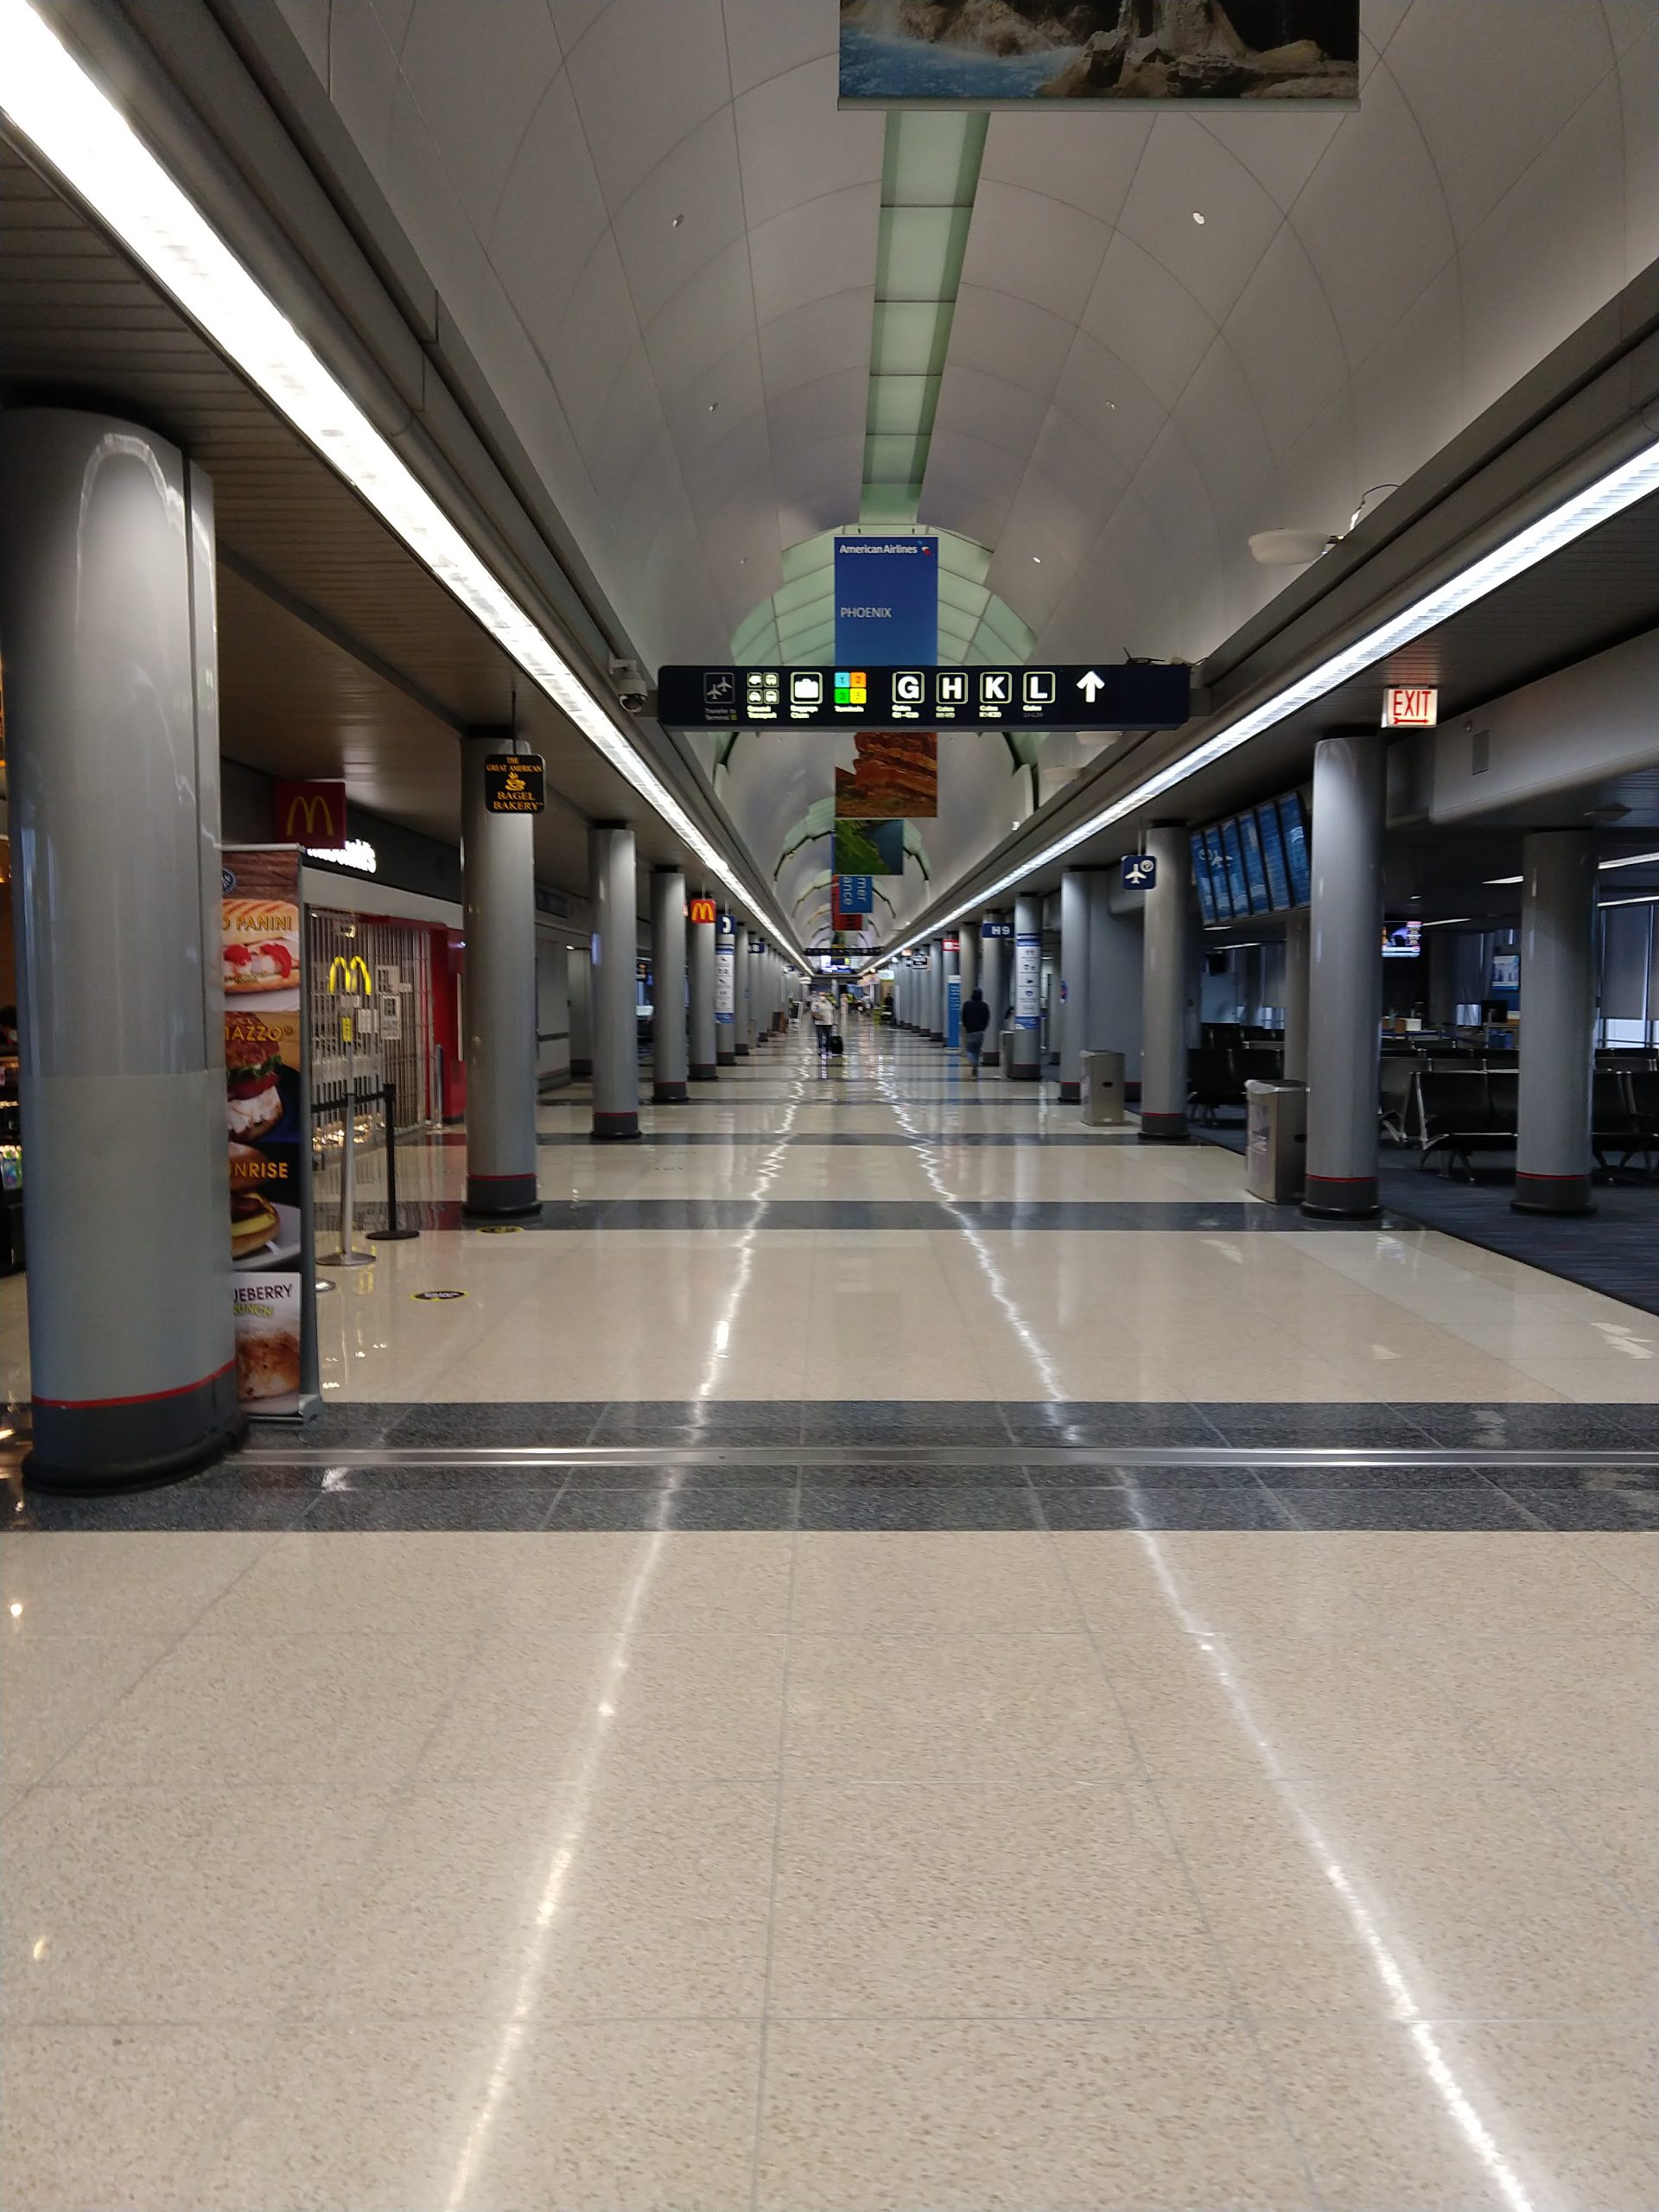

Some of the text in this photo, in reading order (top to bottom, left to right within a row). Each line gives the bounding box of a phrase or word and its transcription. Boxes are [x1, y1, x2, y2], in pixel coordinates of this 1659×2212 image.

[839, 544, 918, 554] American Airlines
[840, 607, 893, 618] PHOENIX
[897, 676, 919, 699] G
[942, 677, 962, 700] H
[985, 676, 1006, 699] K
[1030, 676, 1048, 699] L
[1393, 690, 1431, 716] EXIT
[497, 791, 536, 800] BAGEL
[493, 800, 538, 810] BAKERY
[236, 916, 292, 932] PANINI
[228, 1162, 289, 1179] NRISE
